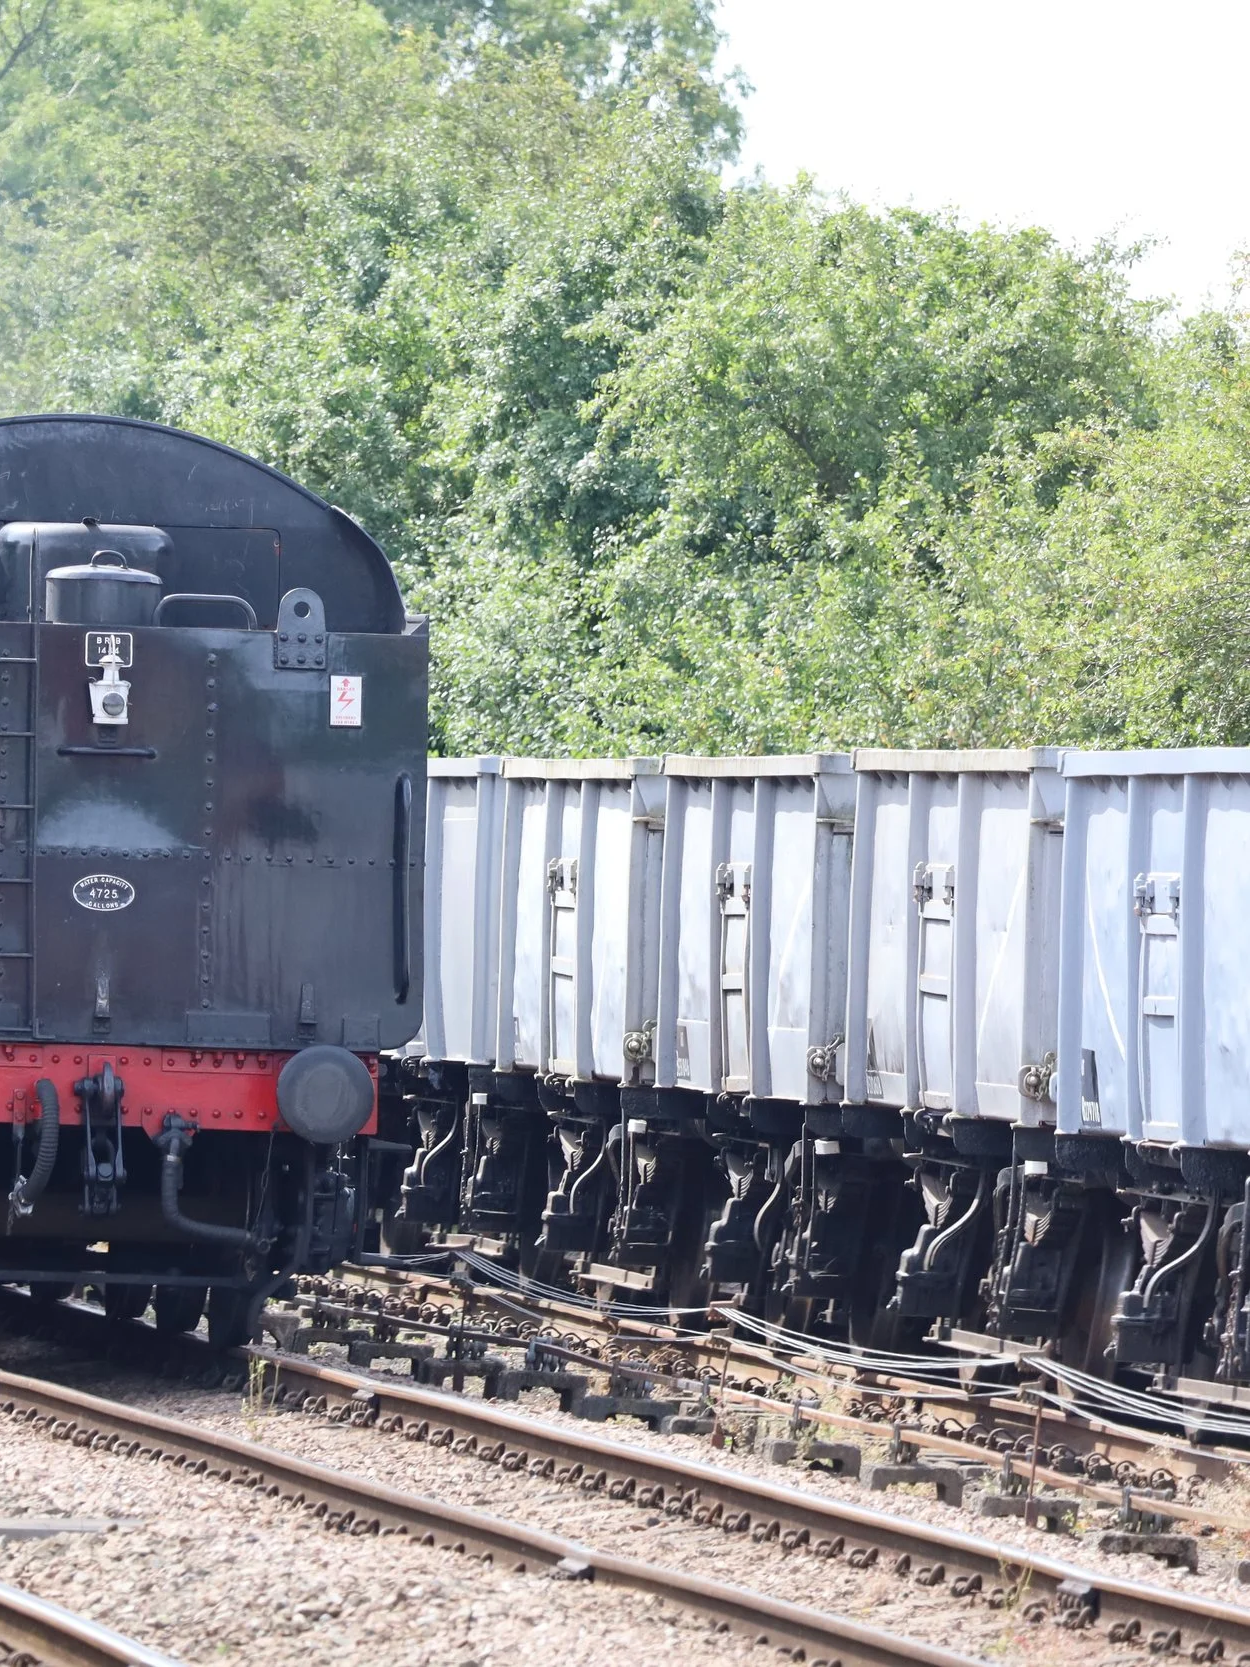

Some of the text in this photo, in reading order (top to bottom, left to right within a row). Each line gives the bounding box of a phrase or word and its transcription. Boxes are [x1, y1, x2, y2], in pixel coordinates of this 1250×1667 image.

[80, 877, 128, 890] WATER CAPACITY
[90, 888, 118, 899] 4725
[88, 901, 119, 909] GALLONS
